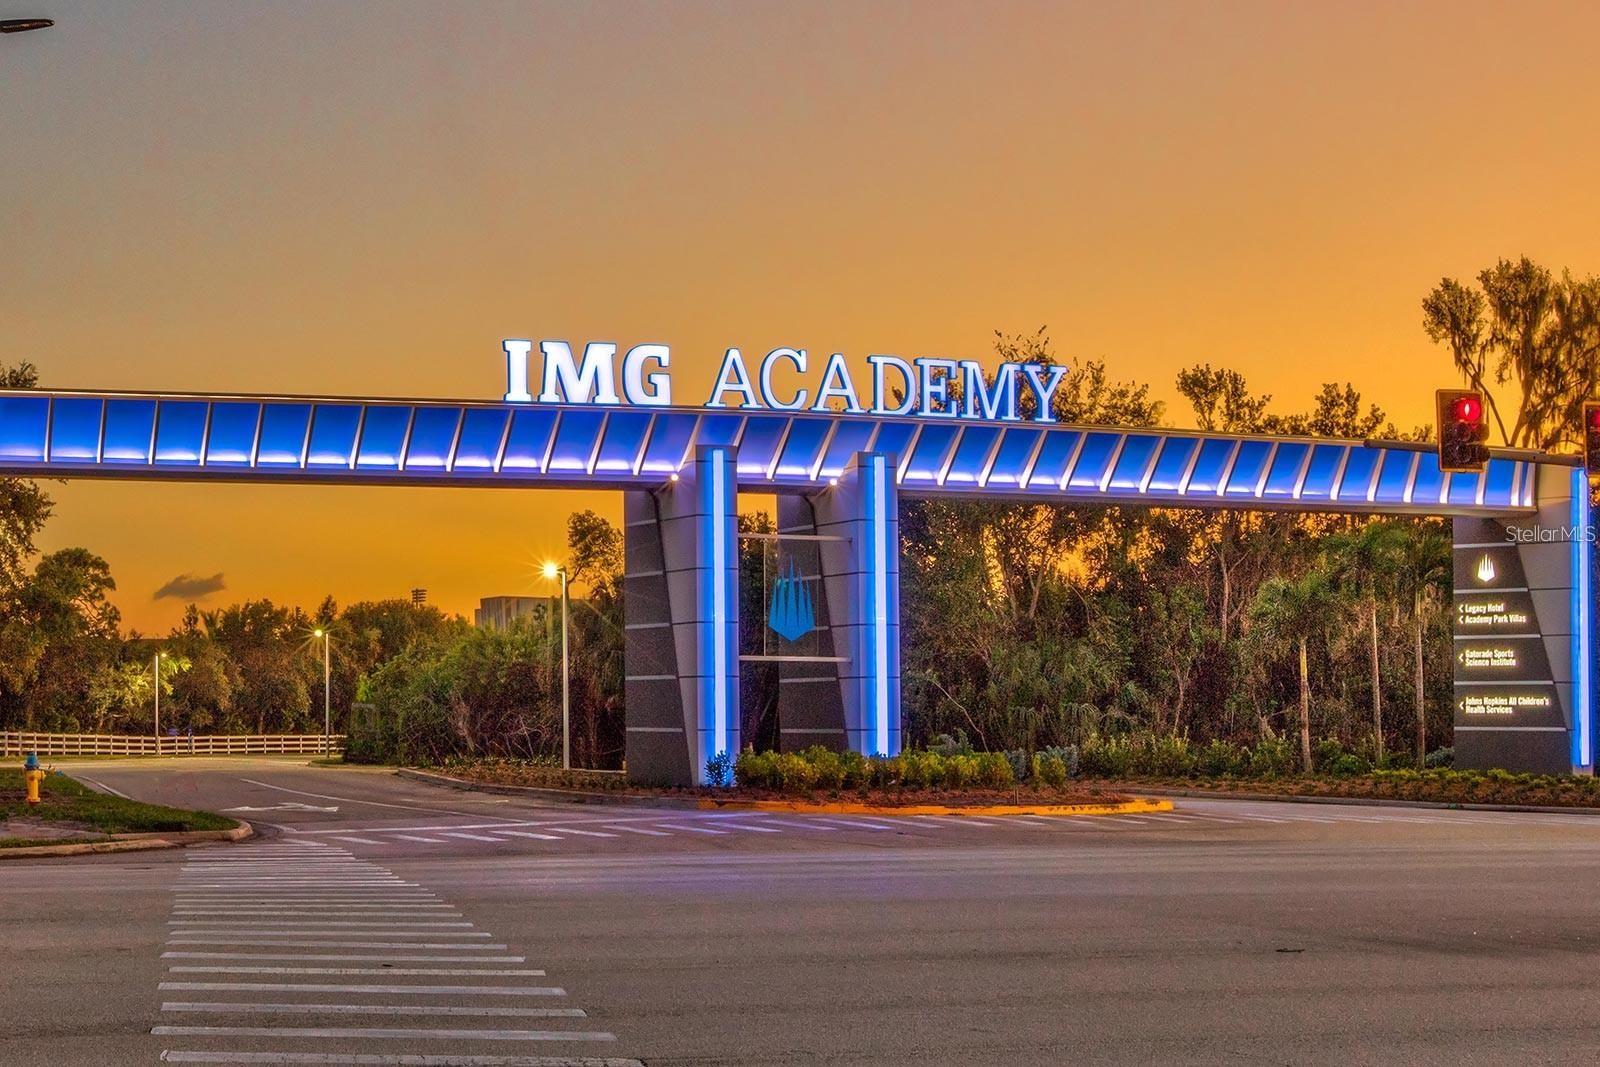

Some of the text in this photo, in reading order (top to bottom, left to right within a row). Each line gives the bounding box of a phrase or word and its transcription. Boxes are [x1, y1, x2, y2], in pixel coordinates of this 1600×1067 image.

[502, 339, 1067, 422] IMG ACADEMY
[1465, 603, 1504, 614] Legacy Hotel
[1465, 614, 1527, 624] Academy Park Villas
[1494, 649, 1514, 658] Sports
[1465, 658, 1516, 666] Science Institute
[1465, 696, 1482, 705] Johns
[1483, 696, 1508, 706] Hopkins
[1509, 696, 1517, 705] All
[1465, 705, 1513, 714] Health Services
